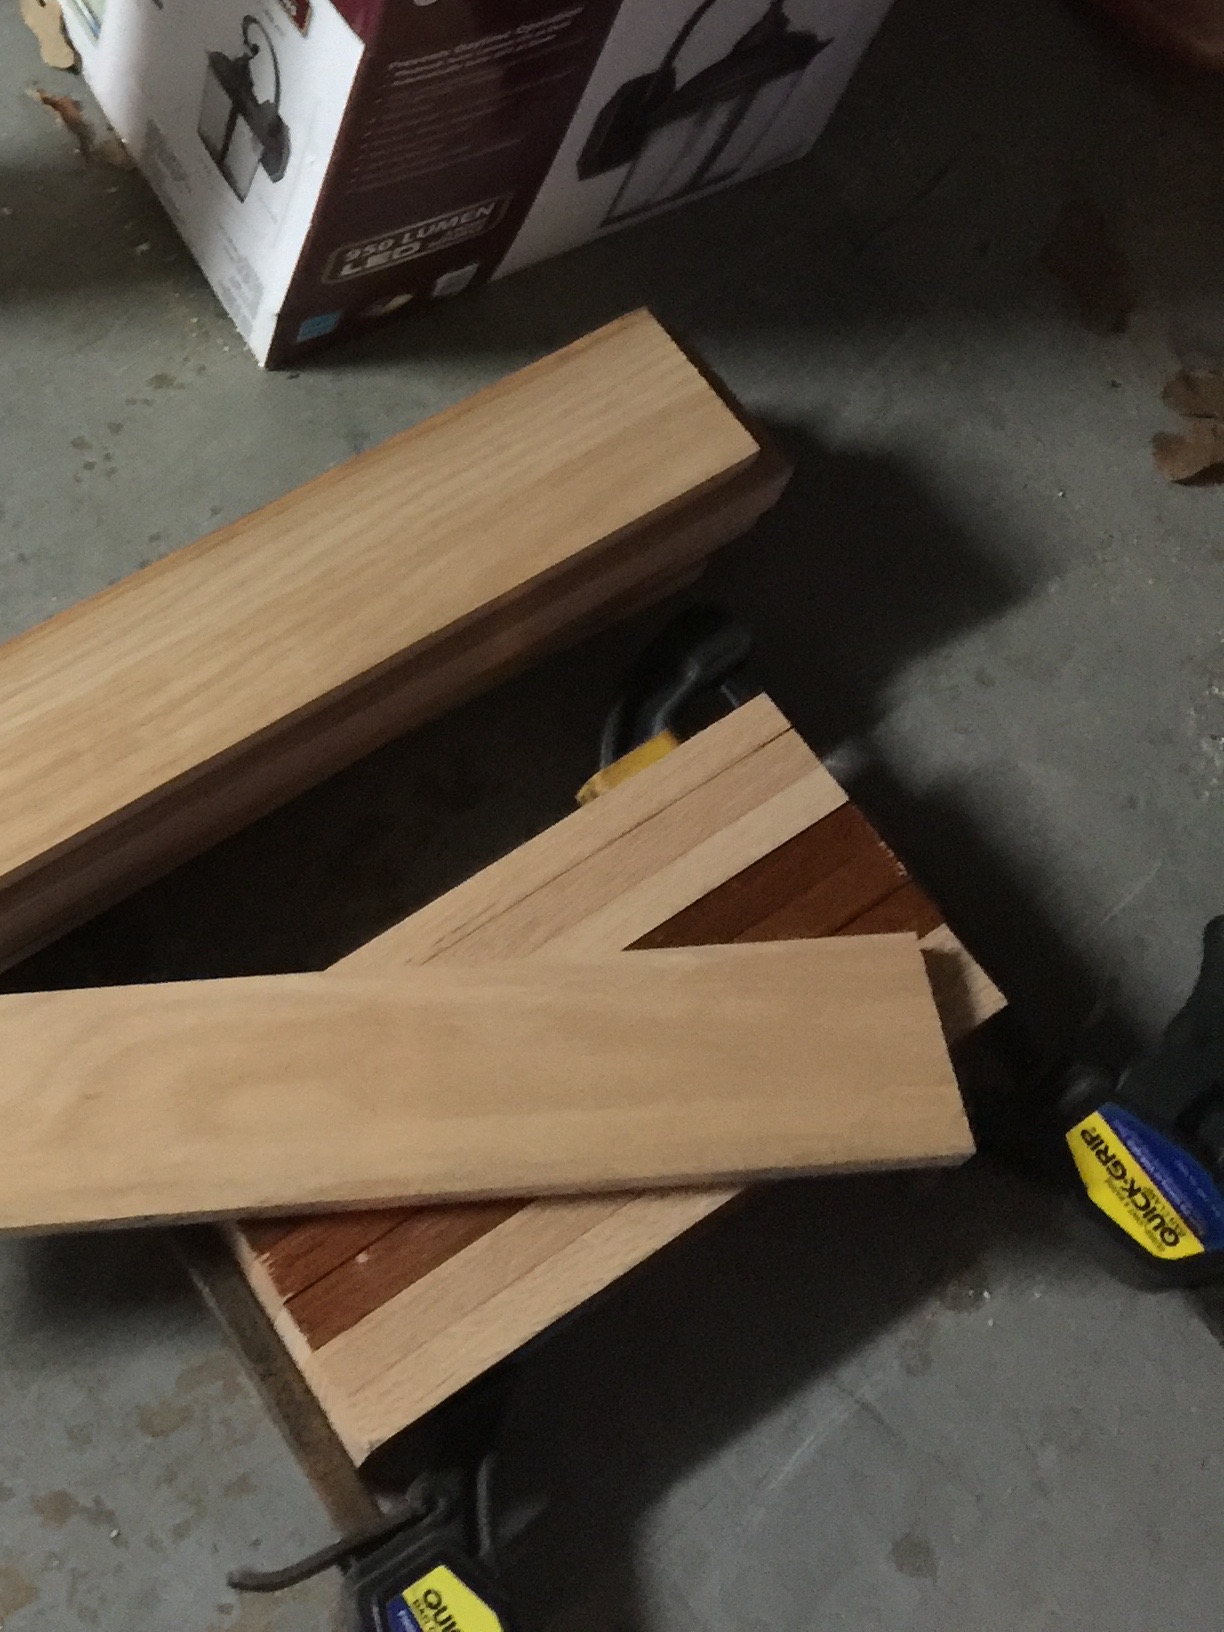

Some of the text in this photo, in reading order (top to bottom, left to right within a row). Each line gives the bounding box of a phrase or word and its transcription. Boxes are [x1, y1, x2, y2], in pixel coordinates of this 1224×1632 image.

[401, 202, 496, 243] LUMEN
[339, 241, 422, 276] LED
[423, 1589, 461, 1632] QUI
